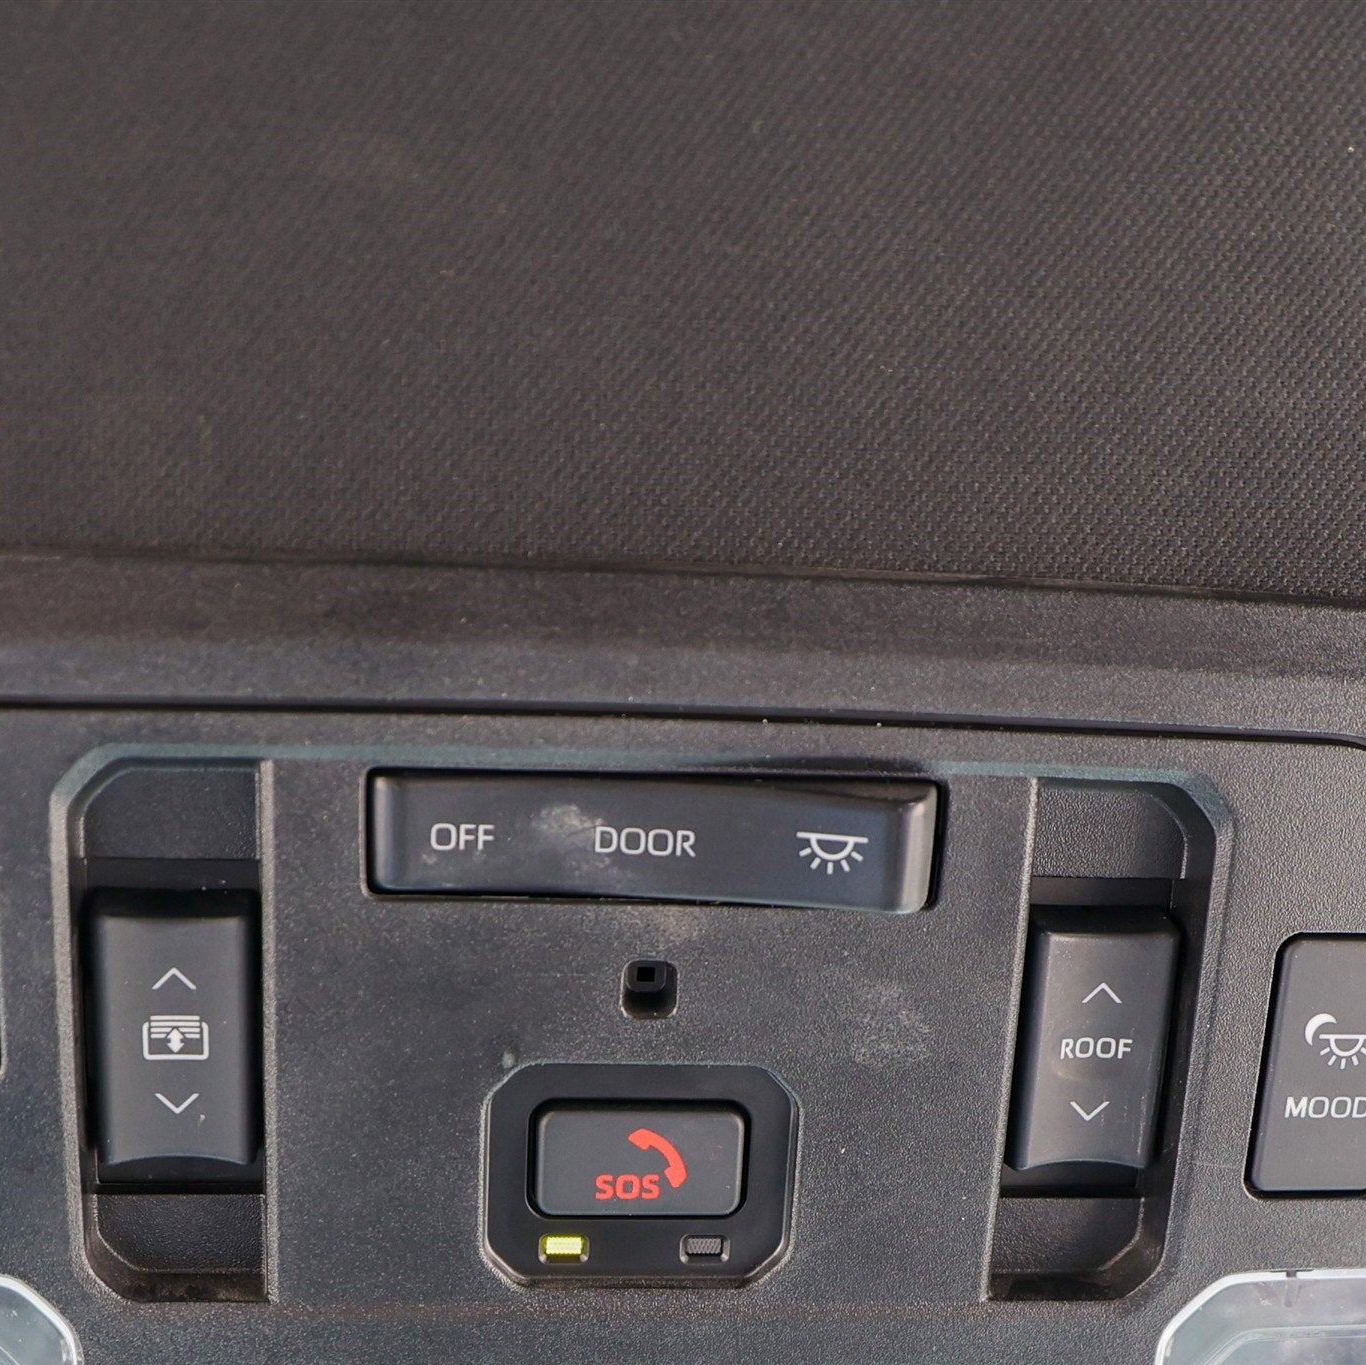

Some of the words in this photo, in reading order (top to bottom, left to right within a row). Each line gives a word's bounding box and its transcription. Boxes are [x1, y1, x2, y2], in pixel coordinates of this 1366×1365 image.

[429, 823, 496, 852] OFF
[594, 825, 697, 858] DOOR
[1059, 1036, 1134, 1061] ROOF
[594, 1173, 661, 1202] SOS
